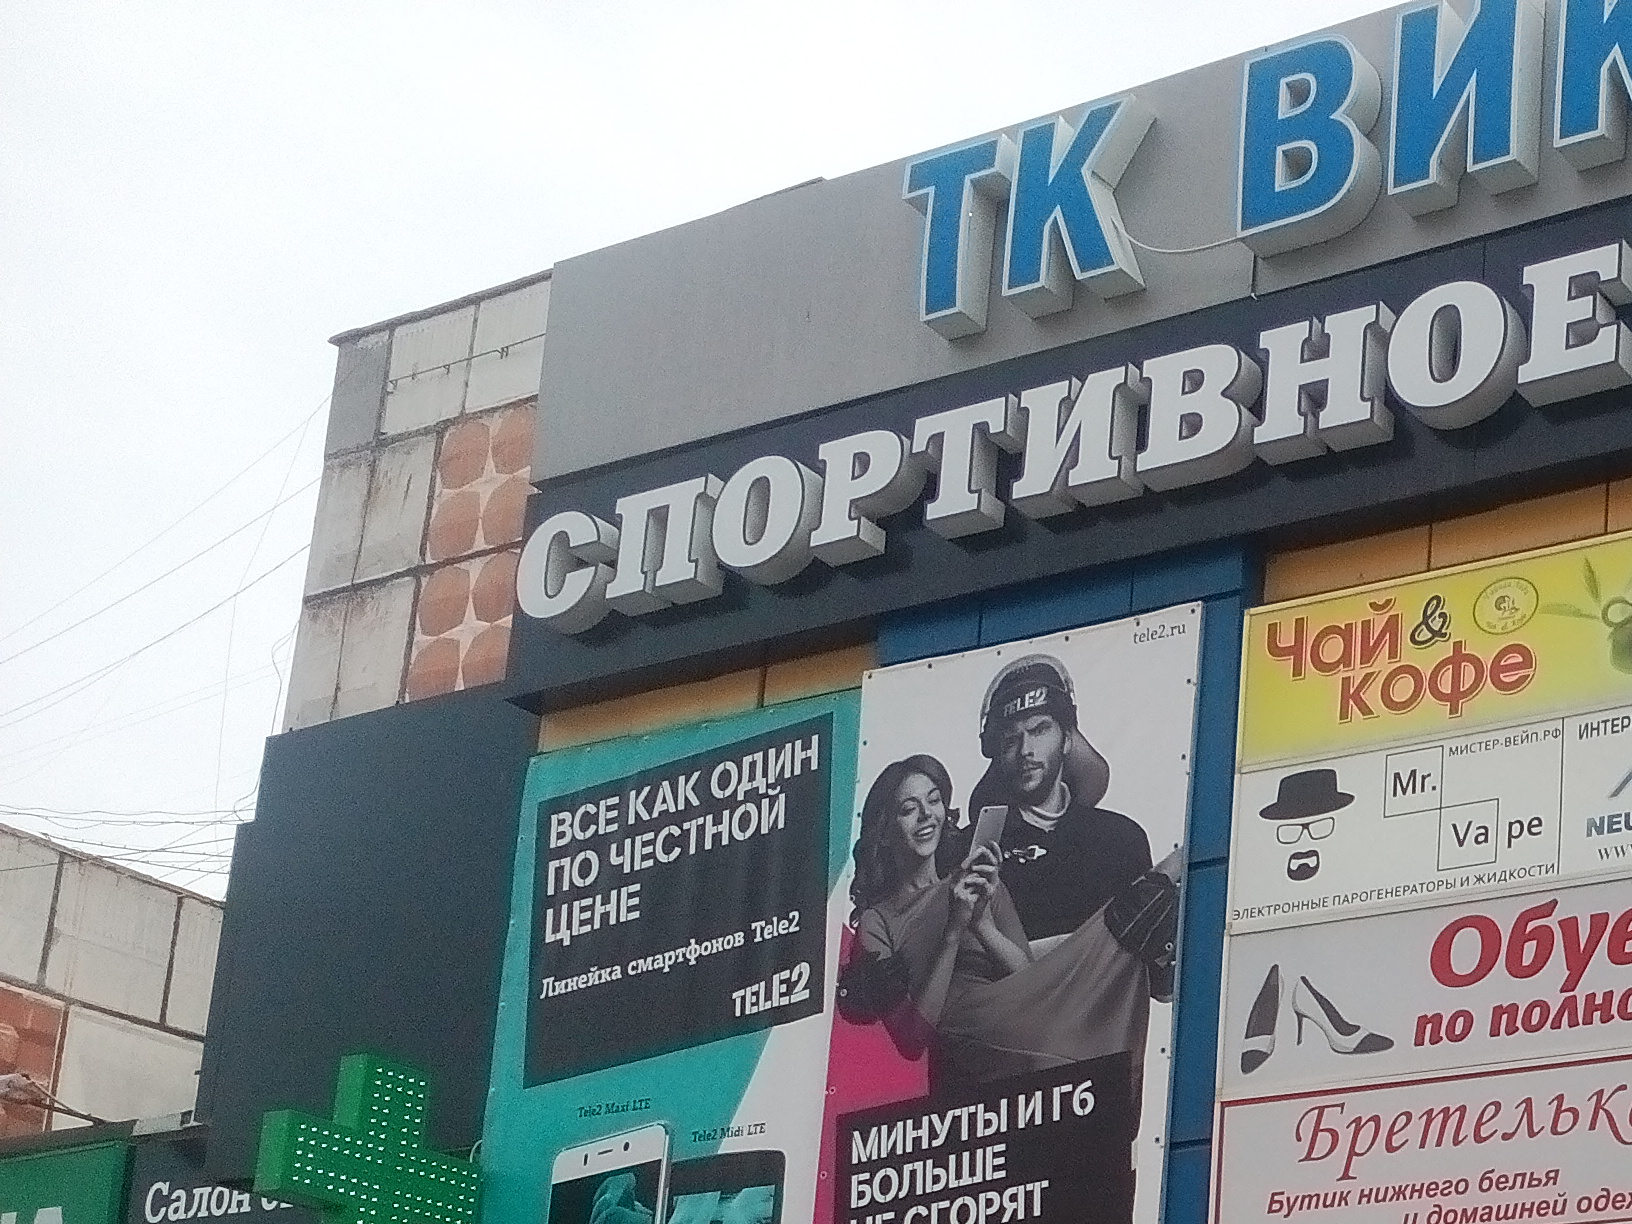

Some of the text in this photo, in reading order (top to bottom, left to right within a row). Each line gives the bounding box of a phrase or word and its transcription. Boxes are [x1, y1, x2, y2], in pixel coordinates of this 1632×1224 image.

[905, 95, 1150, 326] ТК
[515, 240, 1630, 622] СПОРТИВНОЕ
[1133, 622, 1187, 645] tele2.ru
[1266, 598, 1403, 680] Чай
[1409, 594, 1452, 650] &
[1338, 639, 1538, 724] кофе
[1448, 727, 1562, 758] МИСТЕР-ВЕЙП.РФ
[550, 734, 820, 848] ВСЕ КАК ОДИН
[1391, 765, 1438, 799] Mr.
[547, 785, 786, 896] ПО ЧЕСТНОЙ
[545, 883, 641, 946] ЦЕНЕ
[1232, 862, 1556, 921] ЭЛЕКТРОННЫЕ ПАРОГЕНЕРАТОРЫ И ЖИДКОСТИ
[540, 911, 800, 999] Линейка смартфонов Tele2
[732, 961, 811, 1017] TELE2
[1413, 1008, 1474, 1048] по
[632, 1098, 651, 1111] LTE
[692, 1123, 766, 1143] Tele2 Midi LTE
[851, 1098, 1007, 1165] МИНУТЫ
[1018, 1091, 1043, 1129] И
[145, 1180, 251, 1224] Салон
[851, 1144, 1006, 1209] БОЛЬШЕ
[1266, 1168, 1561, 1216] Бутик нижнего белья
